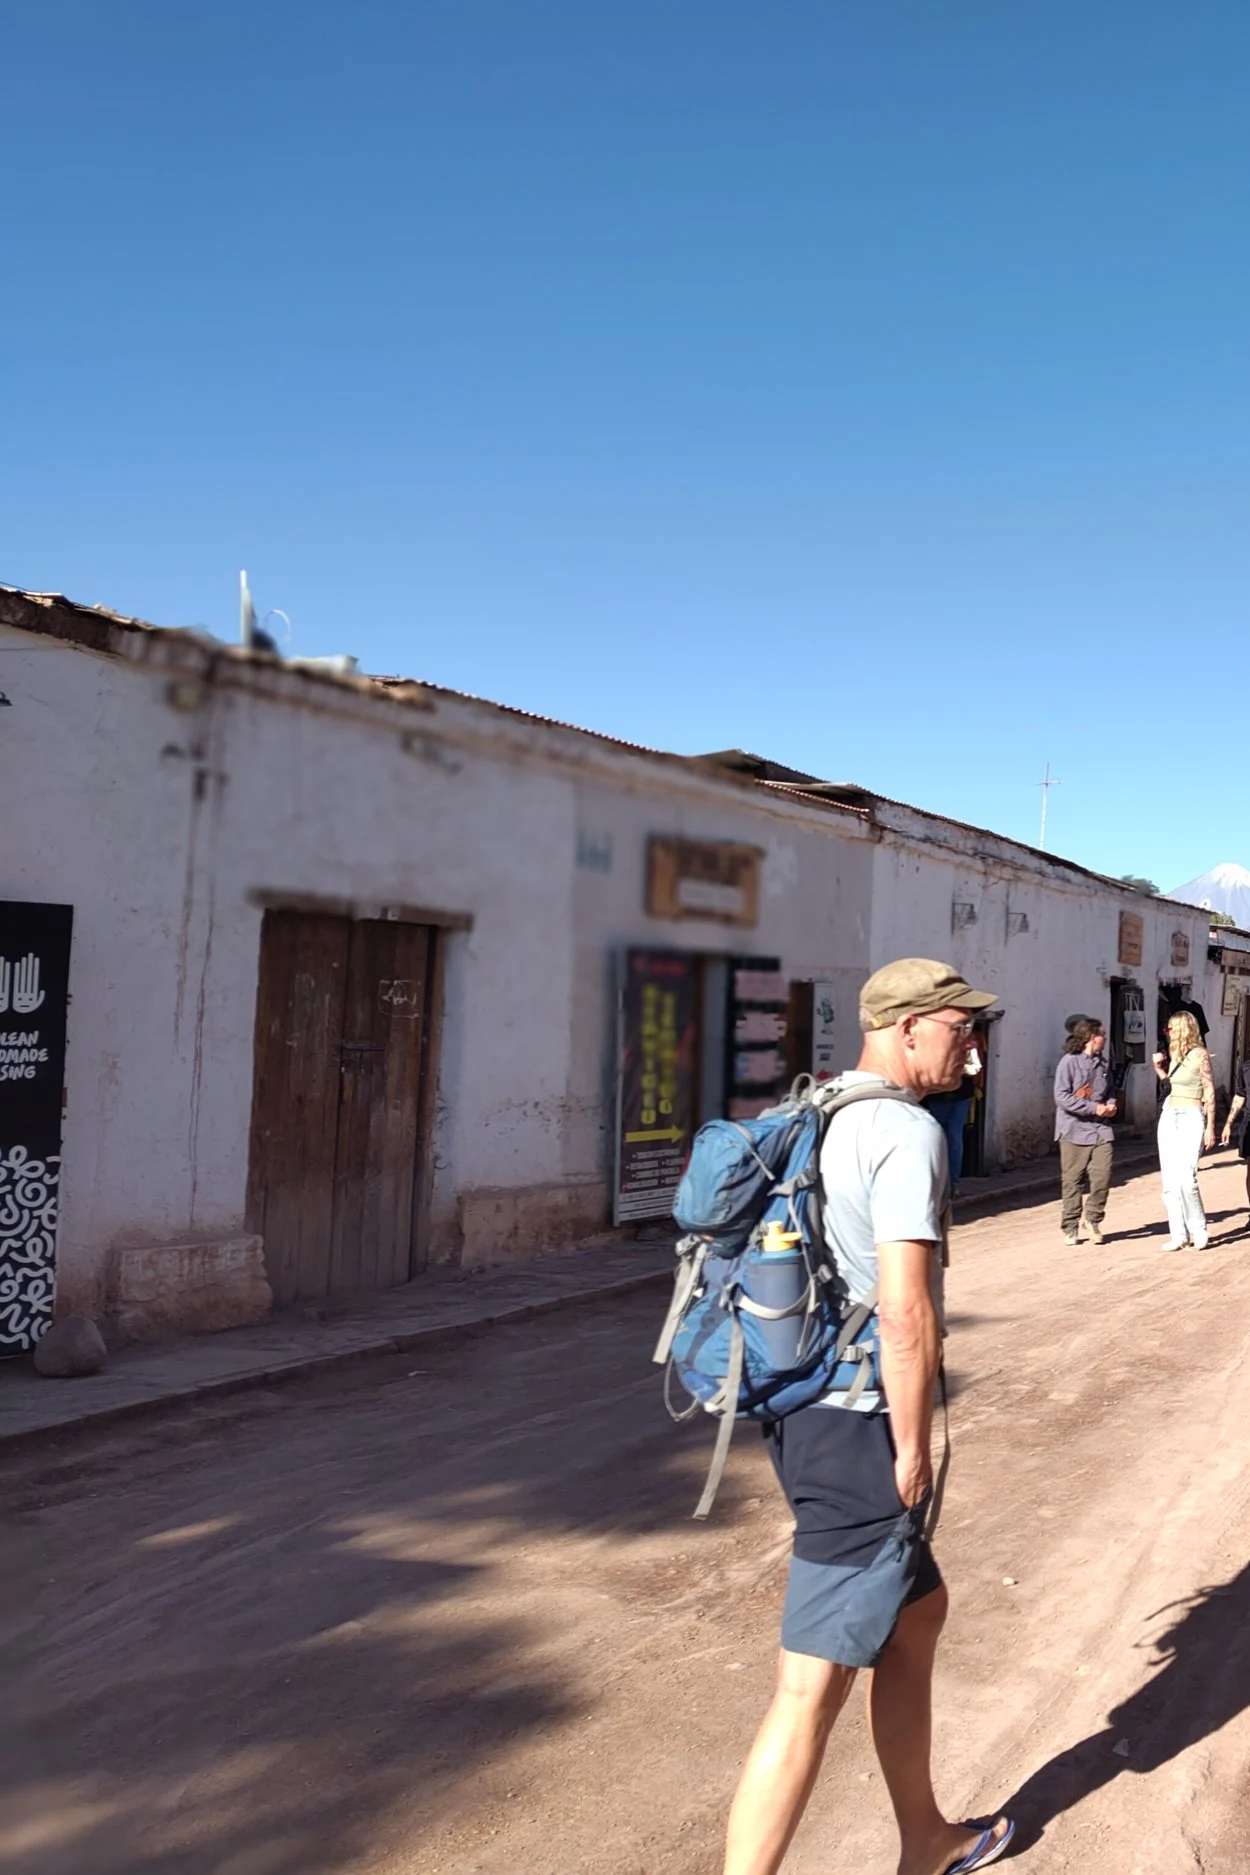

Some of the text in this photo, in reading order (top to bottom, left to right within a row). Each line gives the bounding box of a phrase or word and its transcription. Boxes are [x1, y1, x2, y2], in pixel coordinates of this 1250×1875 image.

[0, 1030, 39, 1047] LEAN
[0, 1048, 49, 1063] DMADE
[0, 1064, 36, 1081] SING
